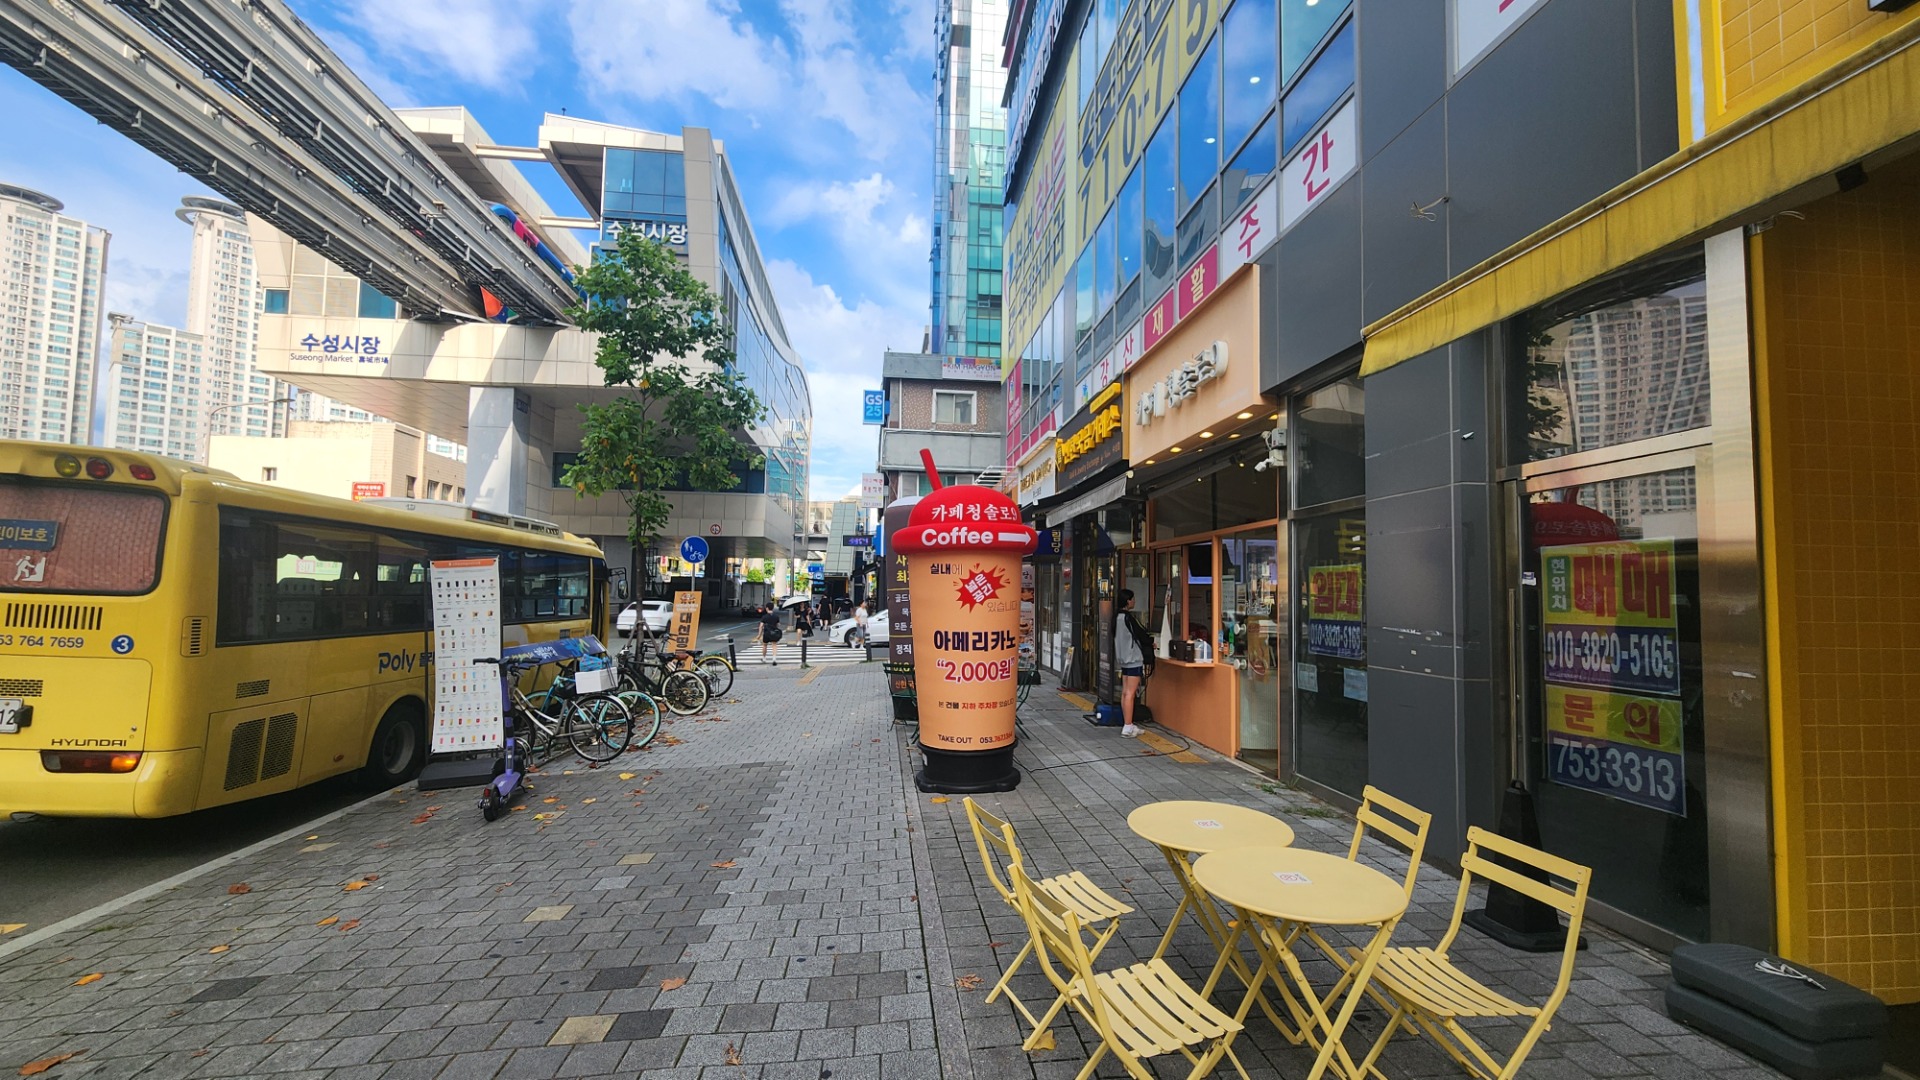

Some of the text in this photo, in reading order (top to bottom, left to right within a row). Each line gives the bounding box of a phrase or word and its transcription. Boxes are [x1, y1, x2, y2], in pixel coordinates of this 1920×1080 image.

[606, 221, 688, 244] 수성시장
[300, 333, 381, 354] 수성시장
[290, 353, 353, 363] Suseong Market
[865, 395, 882, 405] GS
[866, 406, 881, 416] 25
[921, 527, 994, 546] Coffee
[930, 563, 963, 575] 실내에
[964, 573, 988, 594] 넓은
[972, 582, 994, 603] 공간
[1312, 571, 1359, 614] 임대
[1552, 551, 1671, 618] 현위치 매매
[19, 635, 44, 647] 764
[50, 636, 84, 648] 7659
[116, 637, 129, 653] 3
[934, 630, 1016, 652] 아메리카노
[378, 649, 416, 674] Poly
[1547, 630, 1674, 679] 010-3820-5165
[51, 738, 127, 747] HYUNDAI
[938, 734, 955, 743] TAKE
[1553, 737, 1676, 801] 753-3313
